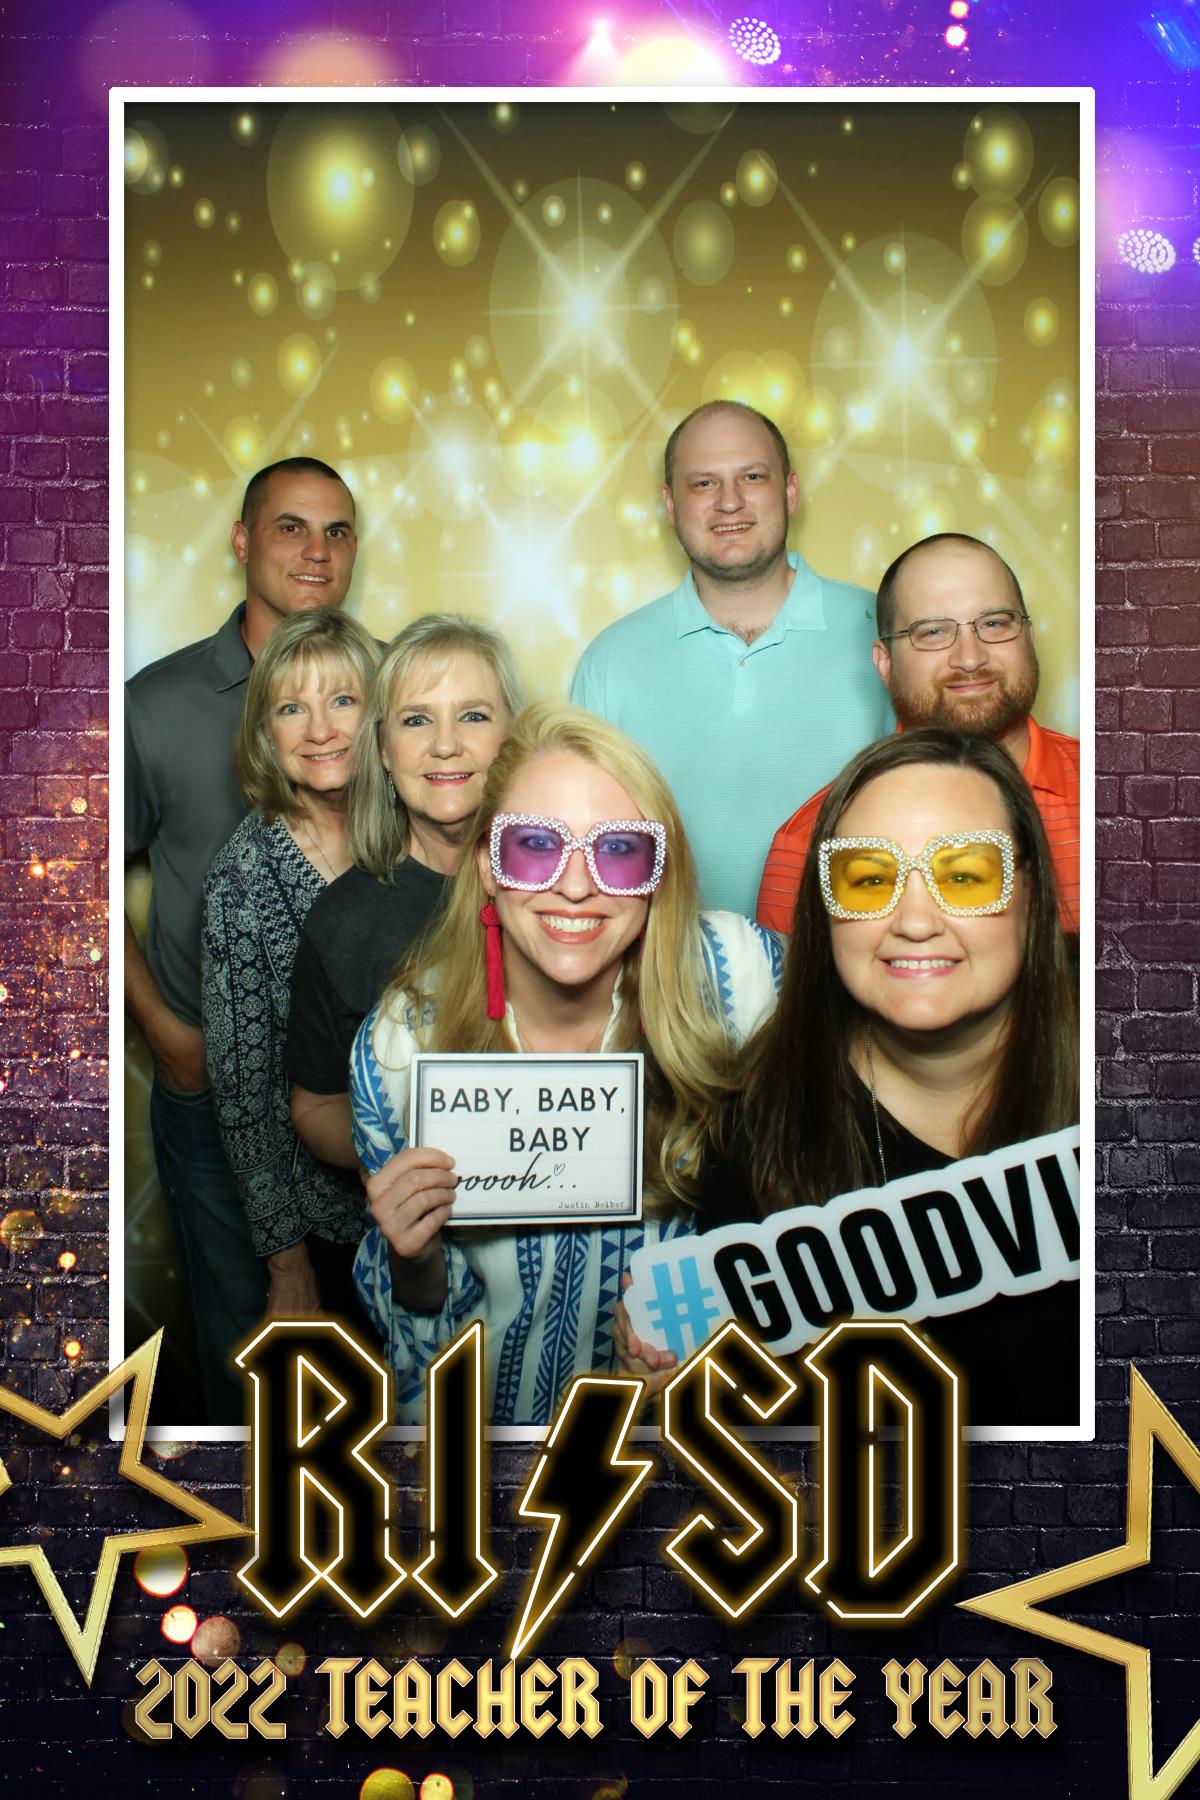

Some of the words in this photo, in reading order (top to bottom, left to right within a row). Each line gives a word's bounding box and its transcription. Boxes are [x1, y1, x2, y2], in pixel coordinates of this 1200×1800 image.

[429, 1087, 520, 1115] BABY,
[537, 1086, 626, 1114] BABY,
[509, 1126, 591, 1152] BABY
